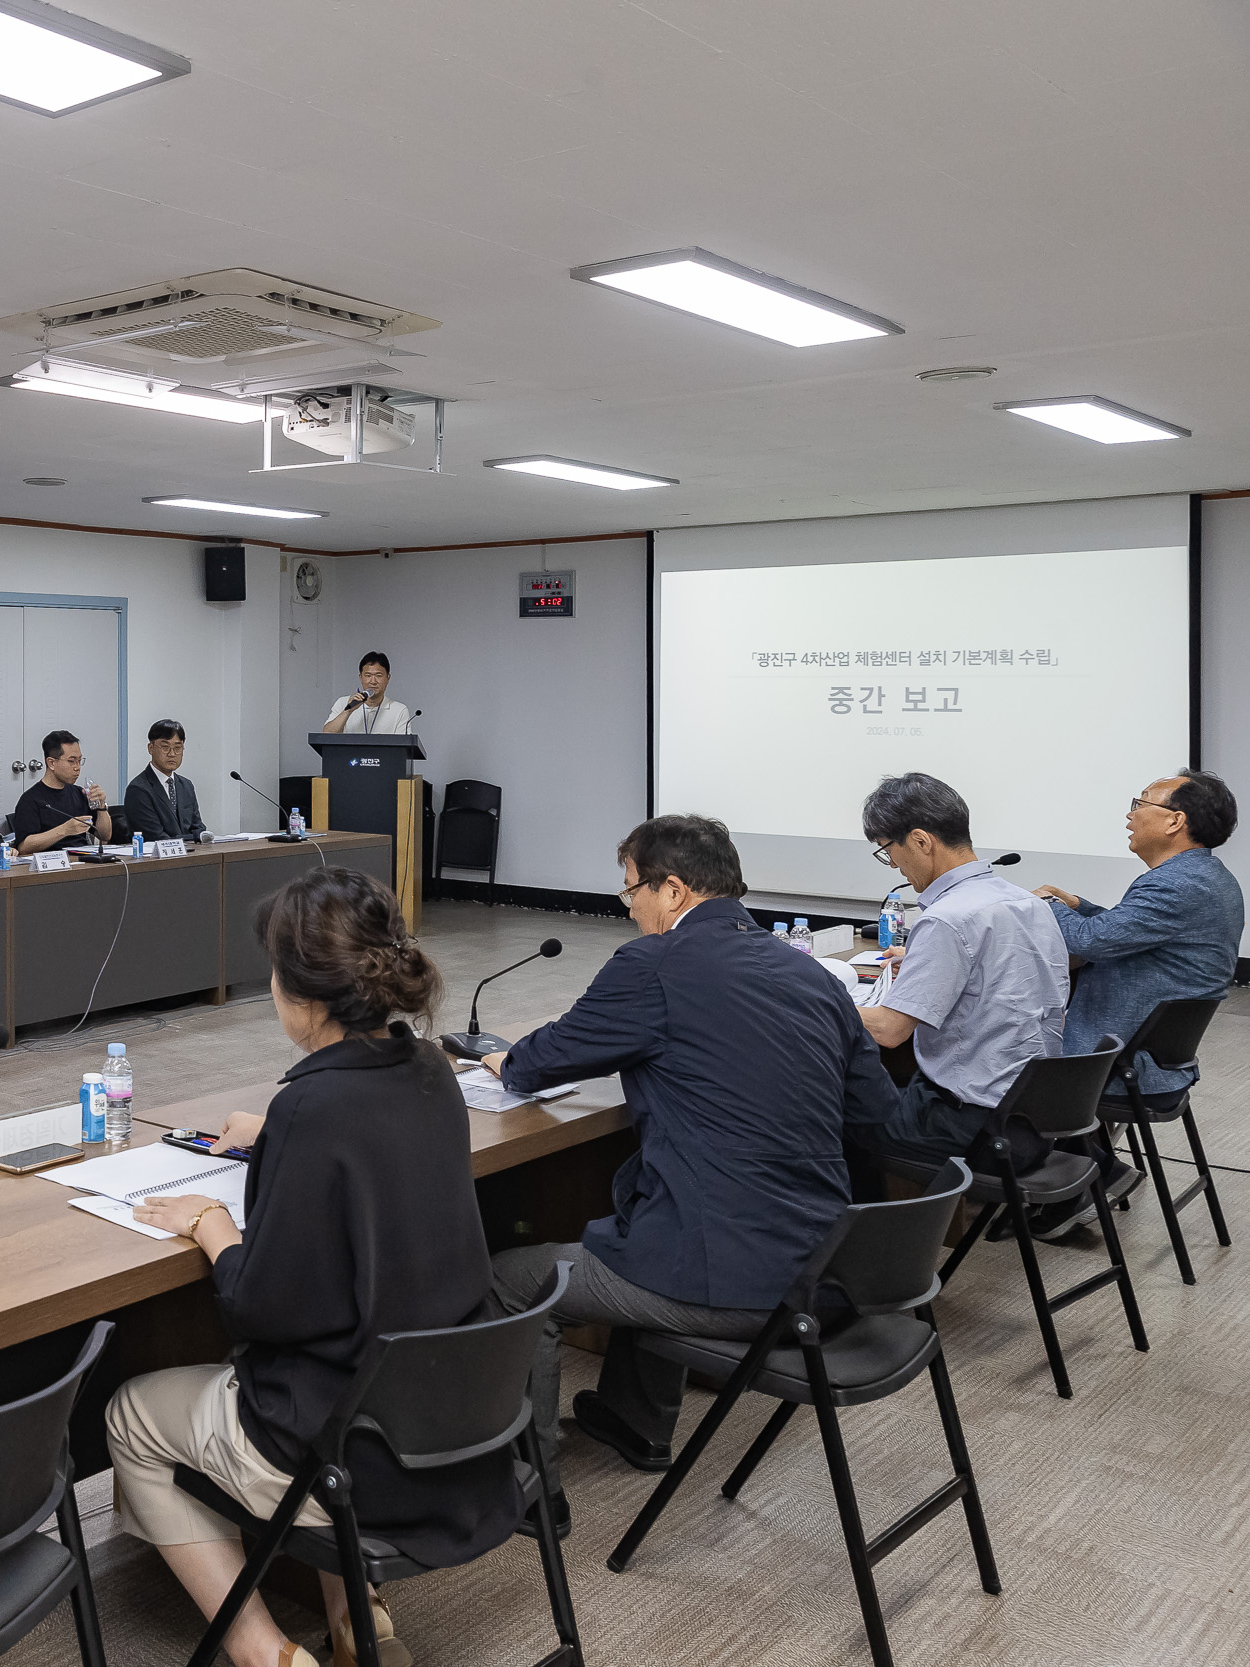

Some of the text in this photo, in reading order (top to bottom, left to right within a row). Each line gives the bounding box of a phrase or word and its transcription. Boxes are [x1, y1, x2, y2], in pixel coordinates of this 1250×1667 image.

[801, 651, 850, 667] 4차산업
[855, 650, 912, 667] 체험센터
[917, 650, 946, 666] 설치
[952, 649, 1014, 666] 기본계획
[828, 685, 963, 715] 중간 보고
